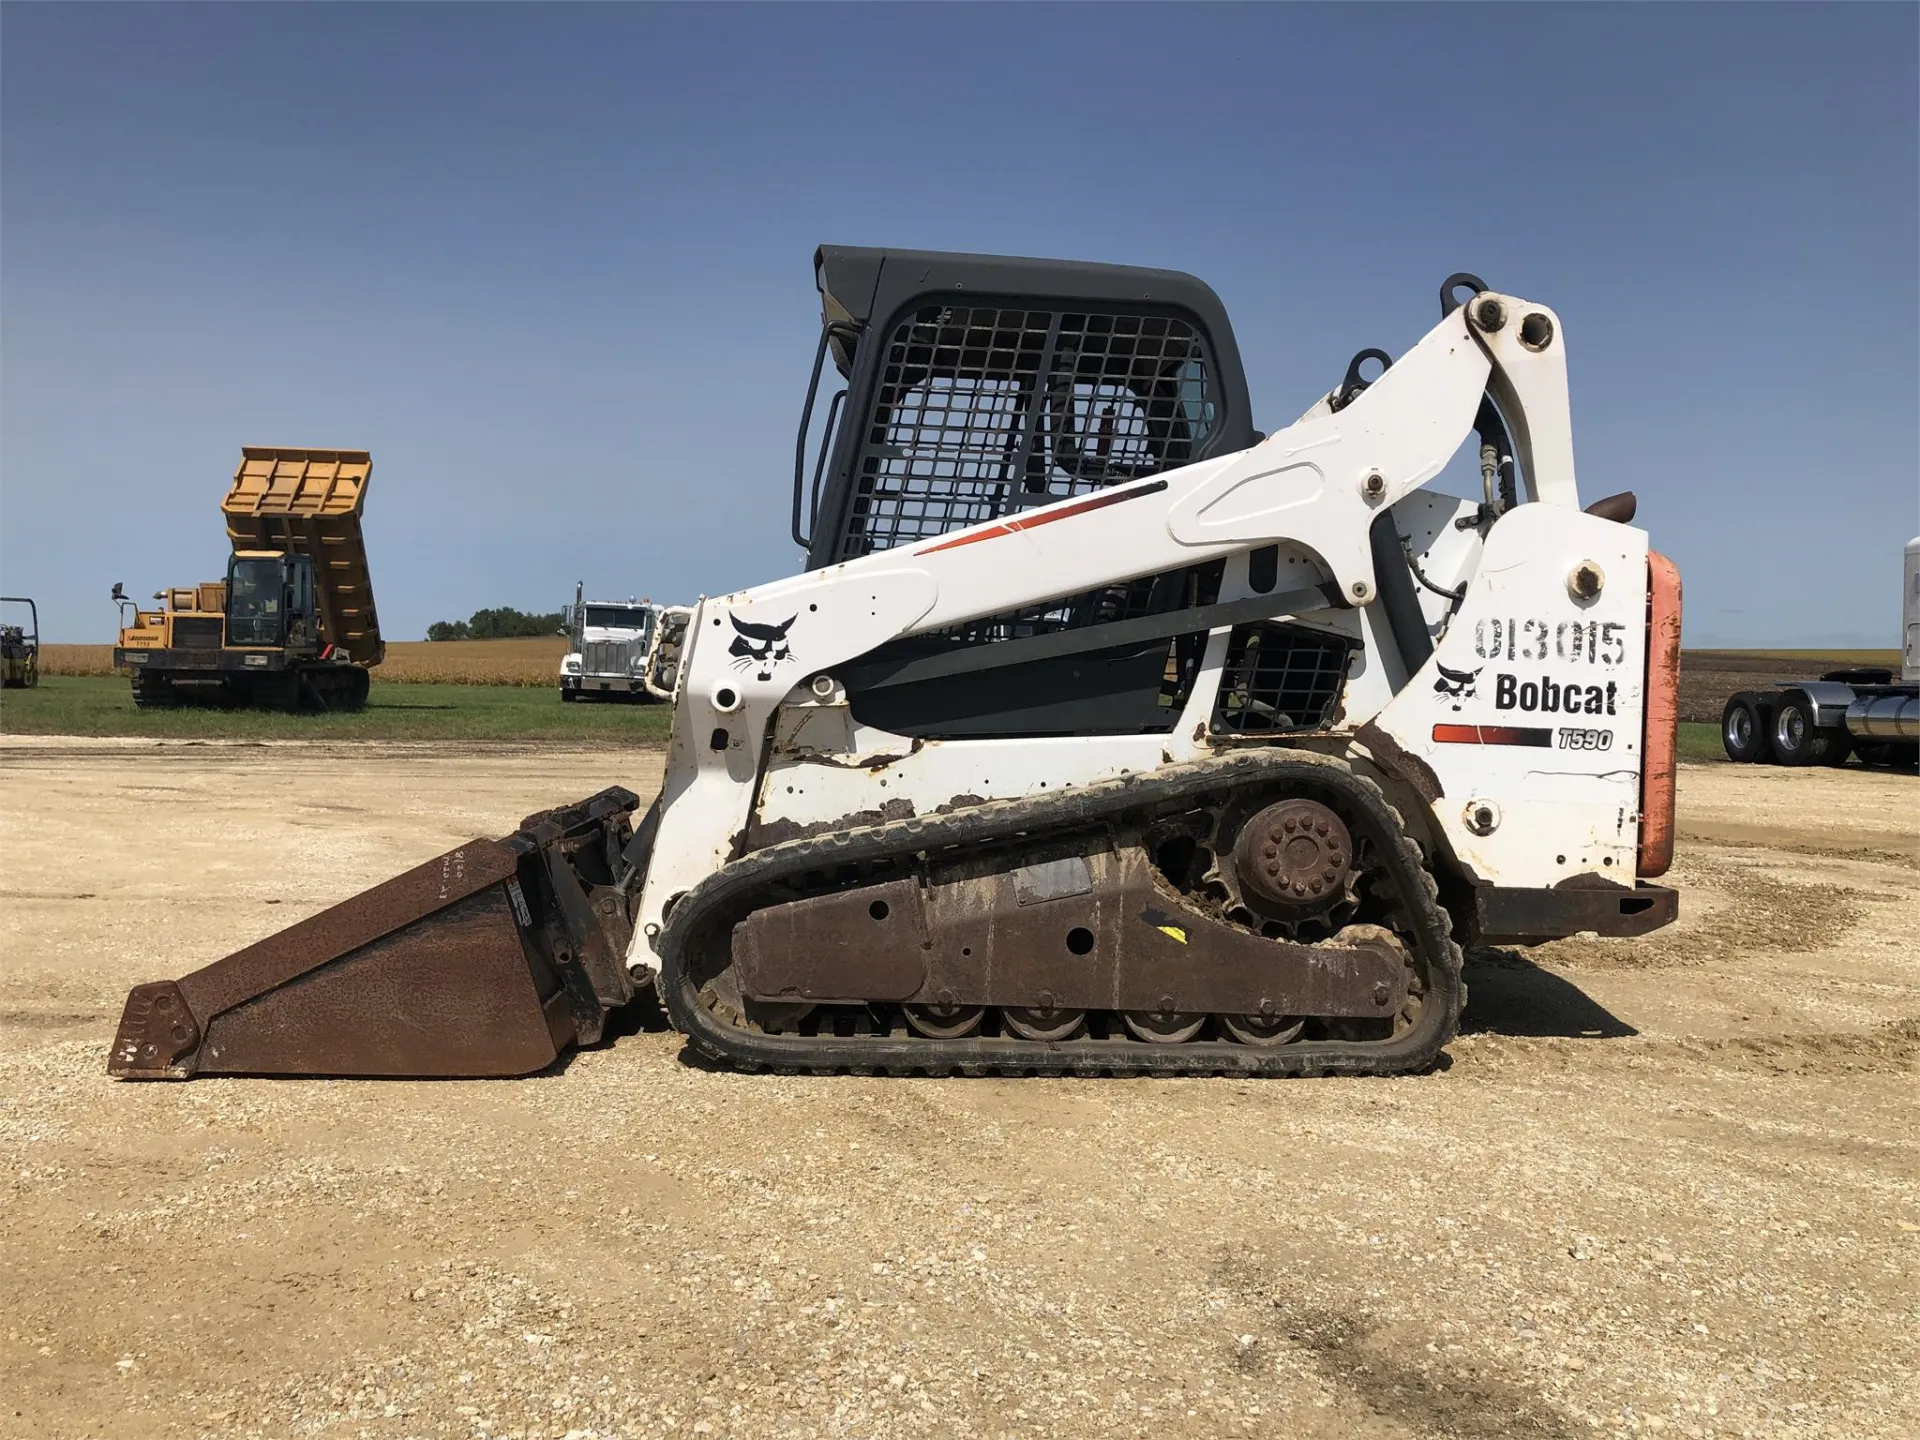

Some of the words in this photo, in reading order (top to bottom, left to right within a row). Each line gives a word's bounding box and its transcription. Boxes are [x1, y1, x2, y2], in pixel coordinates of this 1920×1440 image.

[1475, 618, 1625, 664] 013015
[1495, 673, 1617, 716] Bobcat
[1558, 728, 1613, 751] T590
